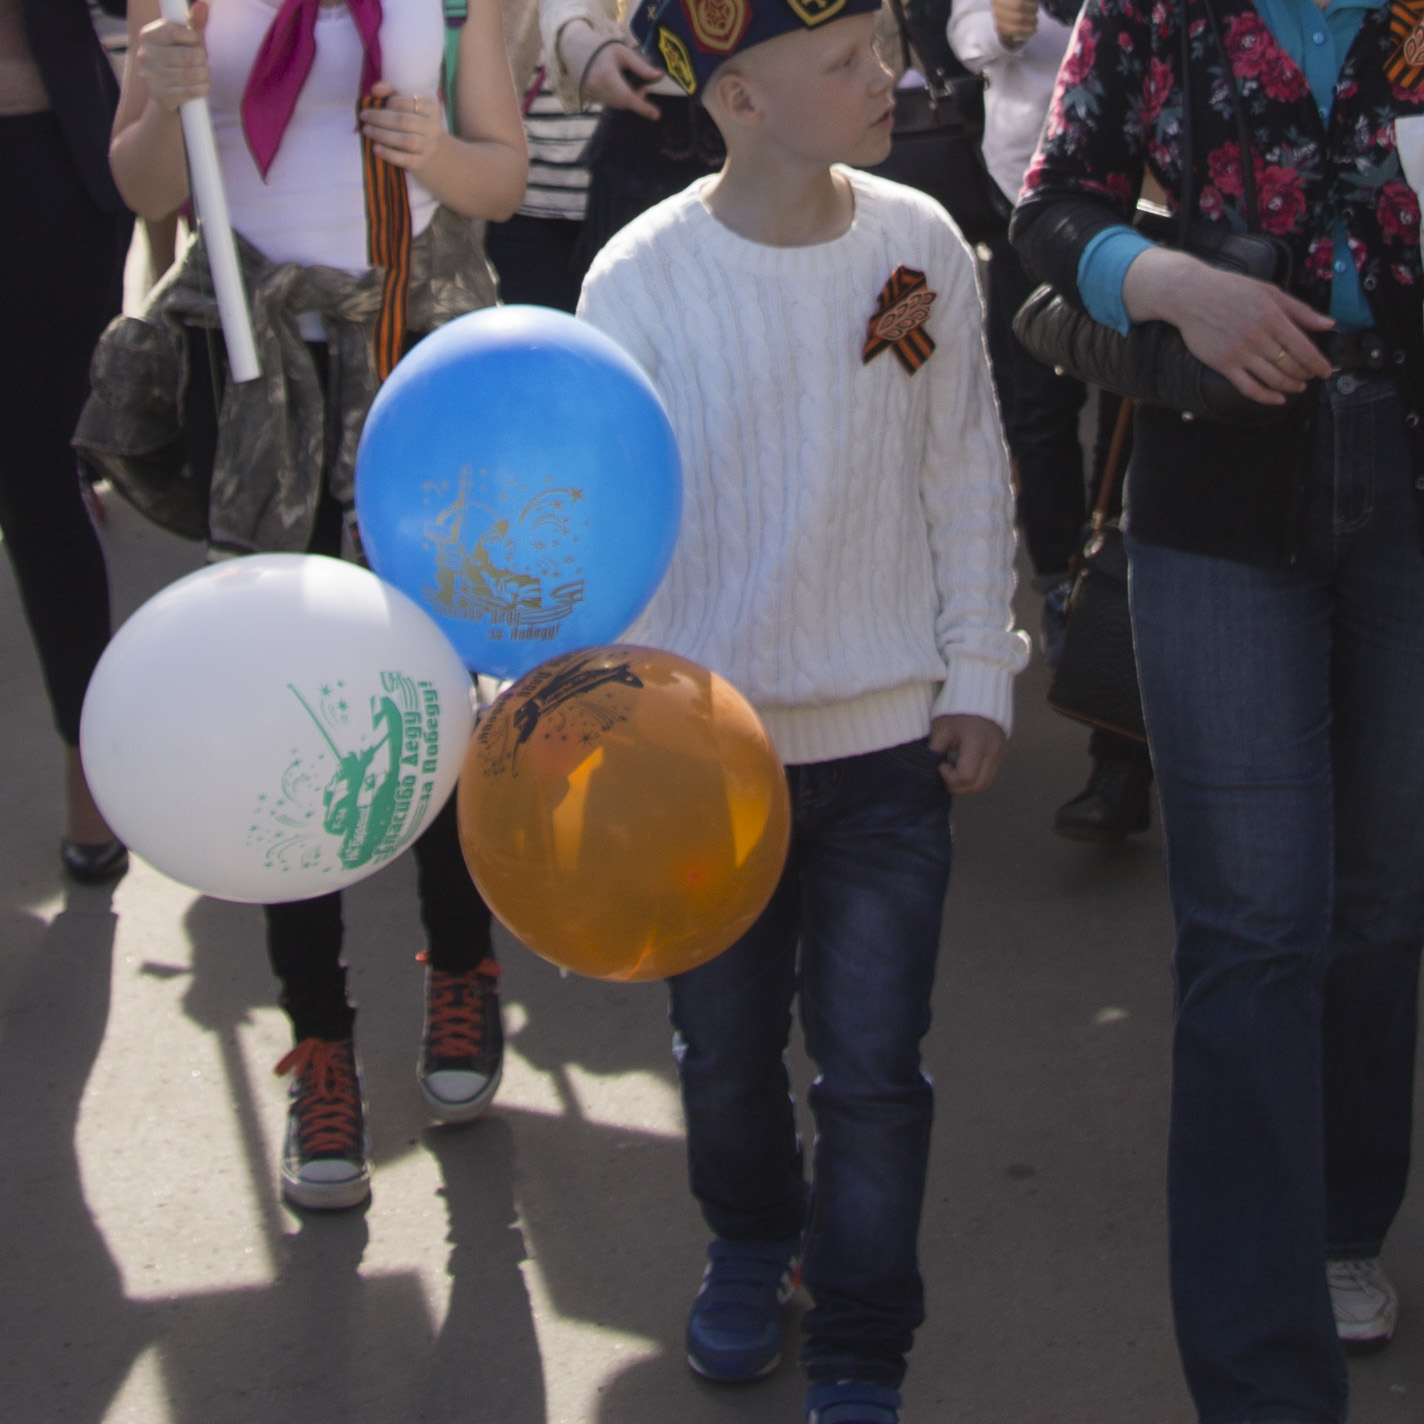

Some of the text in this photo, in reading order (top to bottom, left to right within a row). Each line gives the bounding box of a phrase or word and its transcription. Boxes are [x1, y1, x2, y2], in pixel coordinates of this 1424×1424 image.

[373, 711, 423, 856] Спасибо Деду
[417, 681, 441, 806] за Победу!
